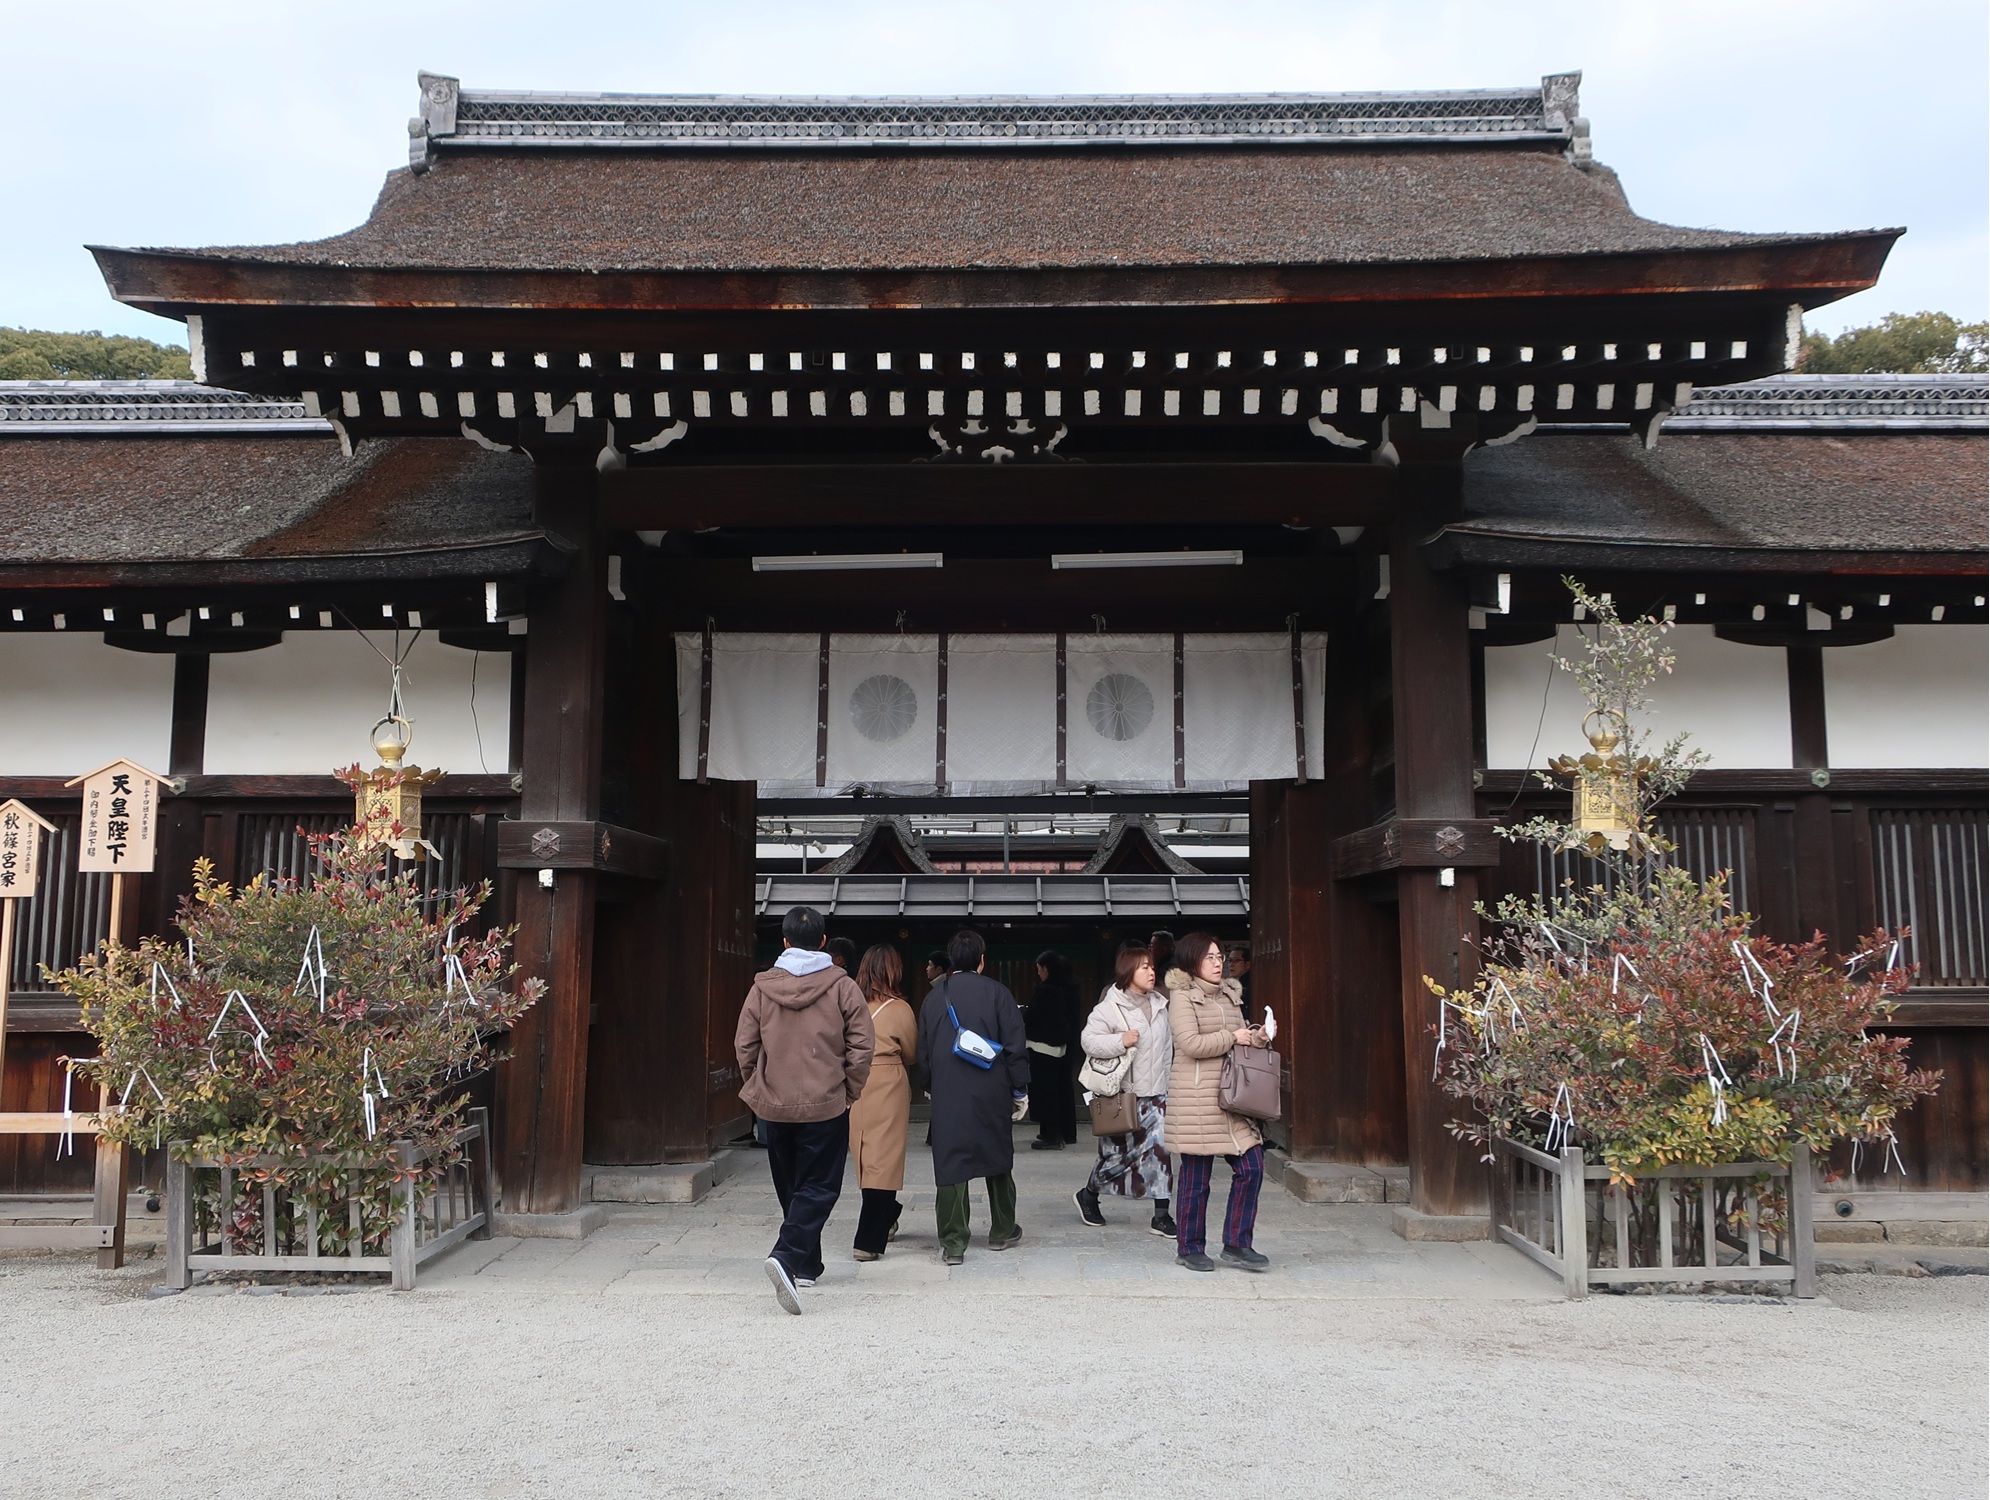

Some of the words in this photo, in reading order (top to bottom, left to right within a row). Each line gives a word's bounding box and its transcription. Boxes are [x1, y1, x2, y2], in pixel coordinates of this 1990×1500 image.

[0, 812, 20, 888] 秋篠宮家
[106, 773, 133, 865] 天皇陛下
